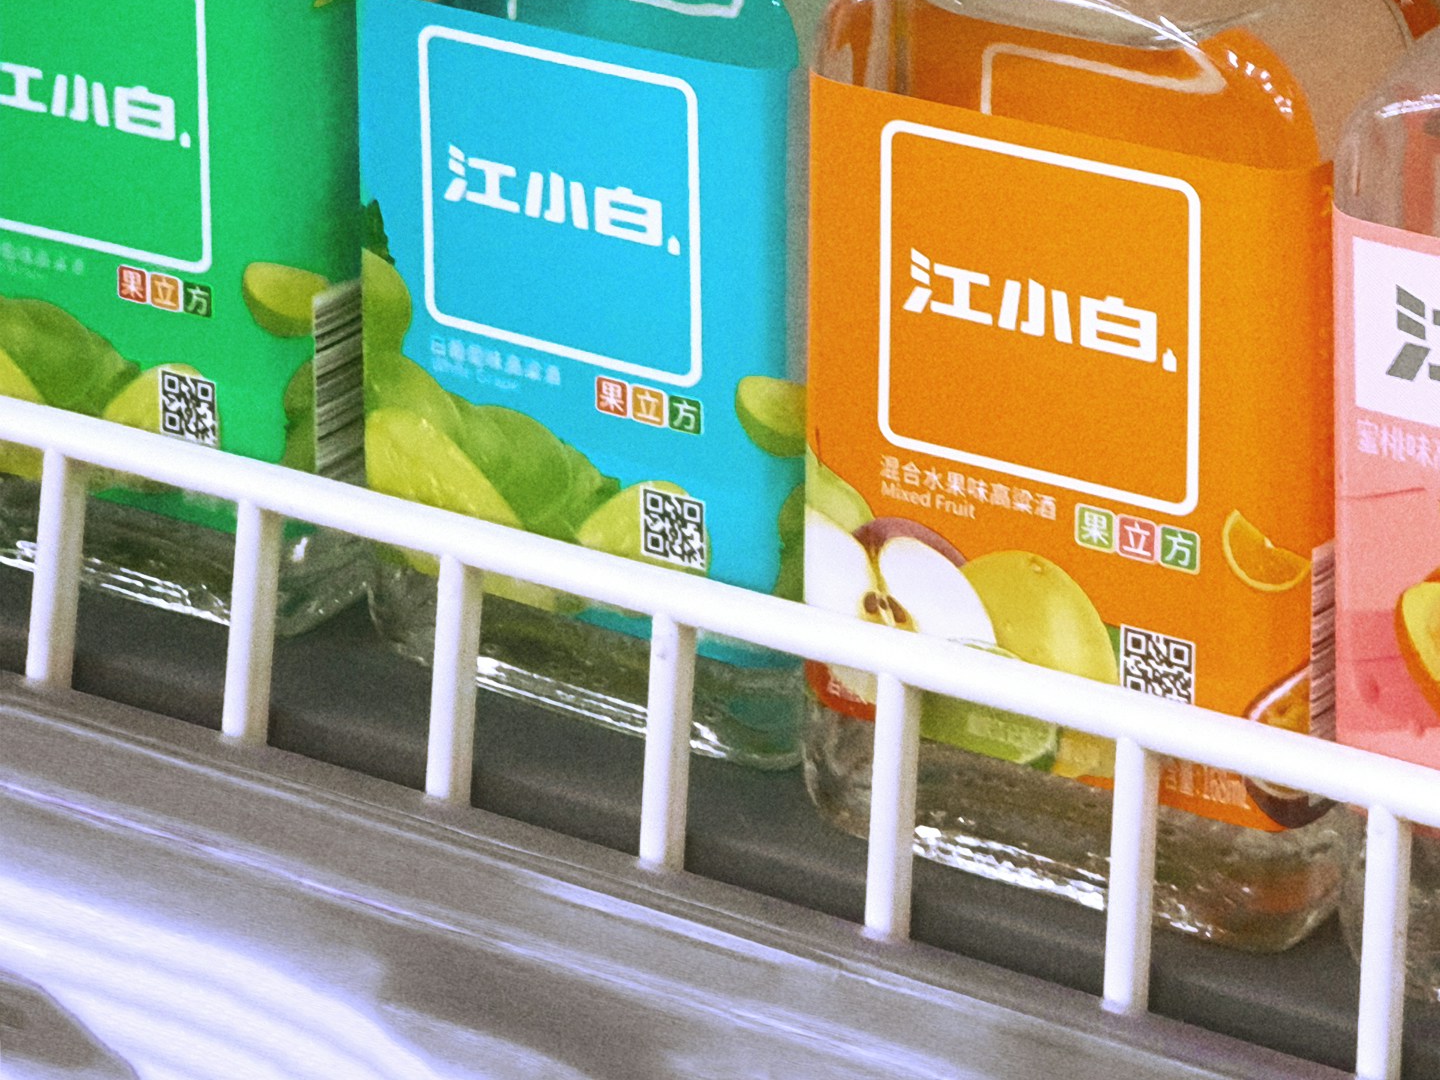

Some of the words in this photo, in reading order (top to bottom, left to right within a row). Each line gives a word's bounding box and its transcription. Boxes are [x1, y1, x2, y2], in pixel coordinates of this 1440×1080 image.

[118, 265, 212, 318] 果立方
[596, 376, 702, 435] 果立方
[880, 454, 1057, 521] 混合水果味高粱酒
[881, 480, 932, 508] Mixed
[935, 493, 976, 520] Fruit
[1075, 503, 1200, 573] 果立方
